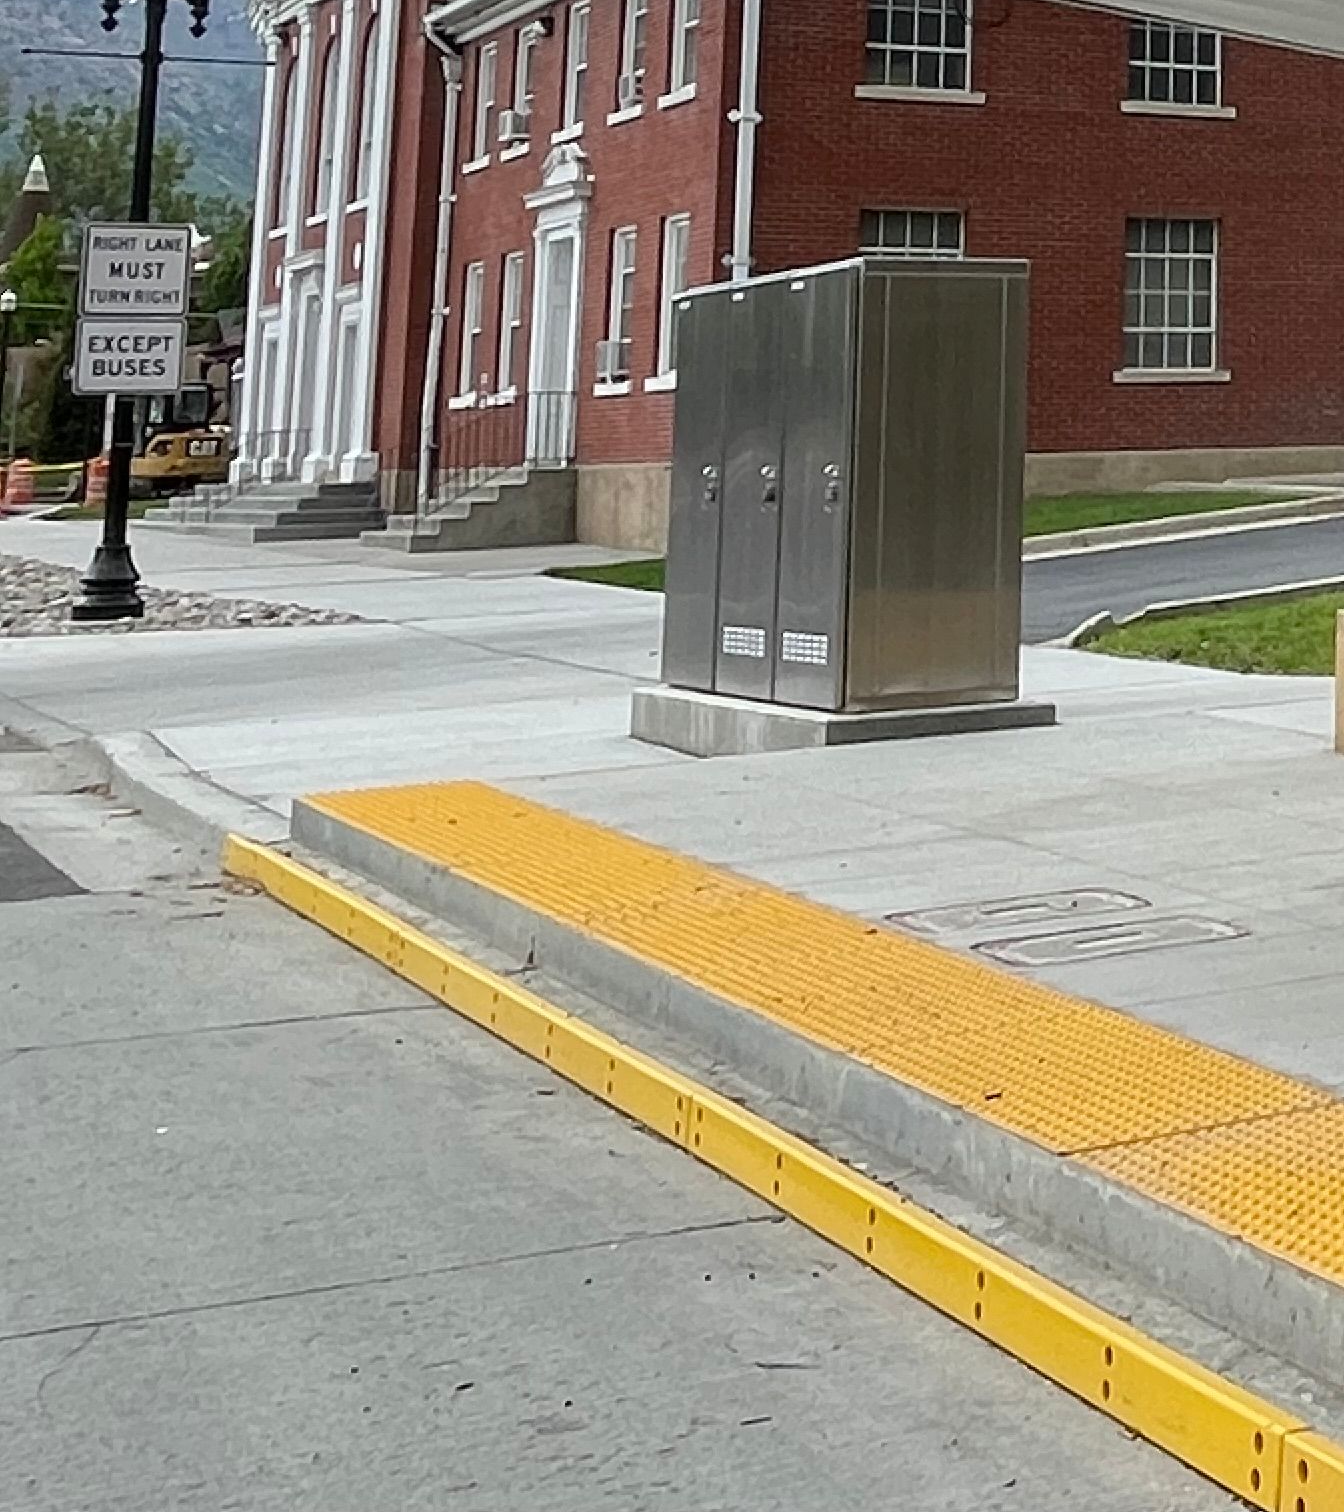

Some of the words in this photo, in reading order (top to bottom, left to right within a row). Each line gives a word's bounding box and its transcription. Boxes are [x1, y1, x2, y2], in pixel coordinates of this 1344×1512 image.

[93, 236, 137, 251] RIGHT
[145, 237, 183, 252] LANE
[109, 262, 165, 280] MUST
[90, 289, 130, 304] TURN
[134, 290, 180, 304] RIGHT
[88, 335, 174, 353] EXCEPT
[92, 358, 166, 376] BUSES
